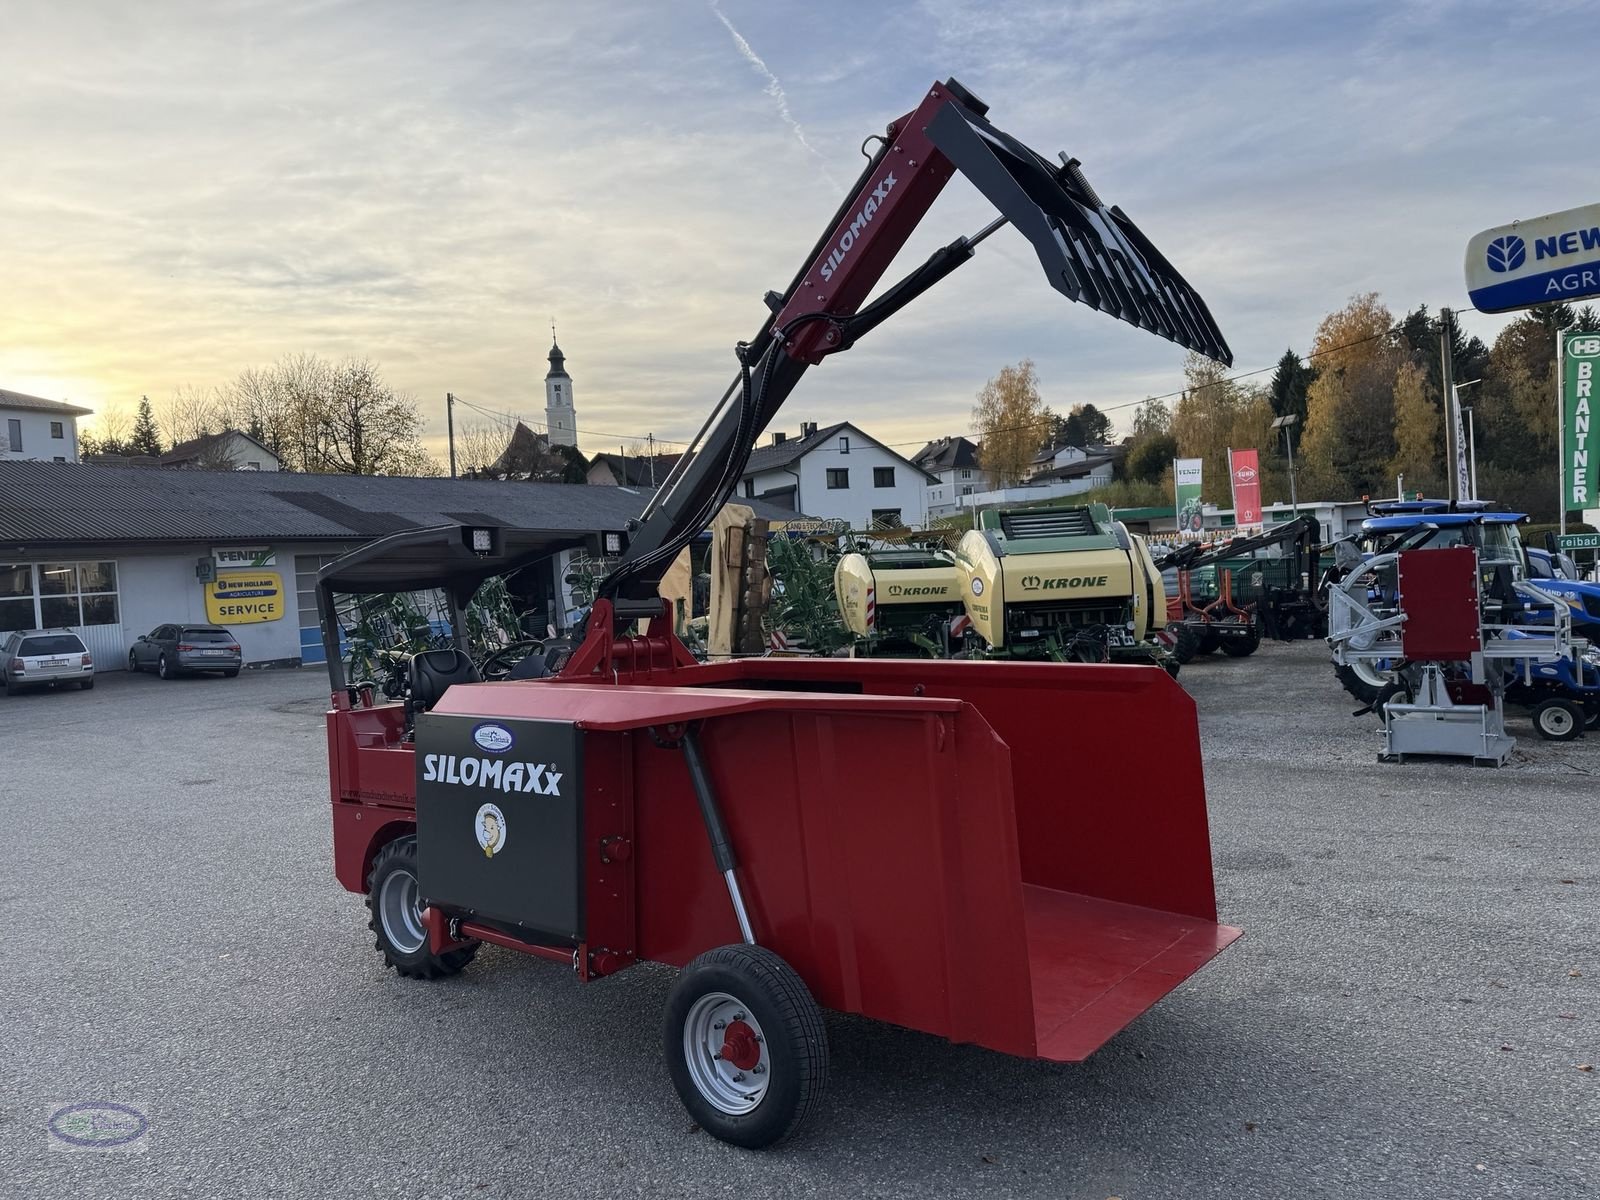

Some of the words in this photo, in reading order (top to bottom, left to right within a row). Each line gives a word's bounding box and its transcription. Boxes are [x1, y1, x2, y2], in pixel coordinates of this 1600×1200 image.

[1535, 227, 1600, 261] NEW
[1573, 340, 1600, 354] HB
[1573, 361, 1593, 503] BRANTNER
[1557, 535, 1598, 547] reibad
[244, 580, 272, 588] HOLLAND
[1042, 576, 1108, 589] KRONE
[903, 586, 949, 596] KRONE
[219, 603, 275, 616] SERVICE
